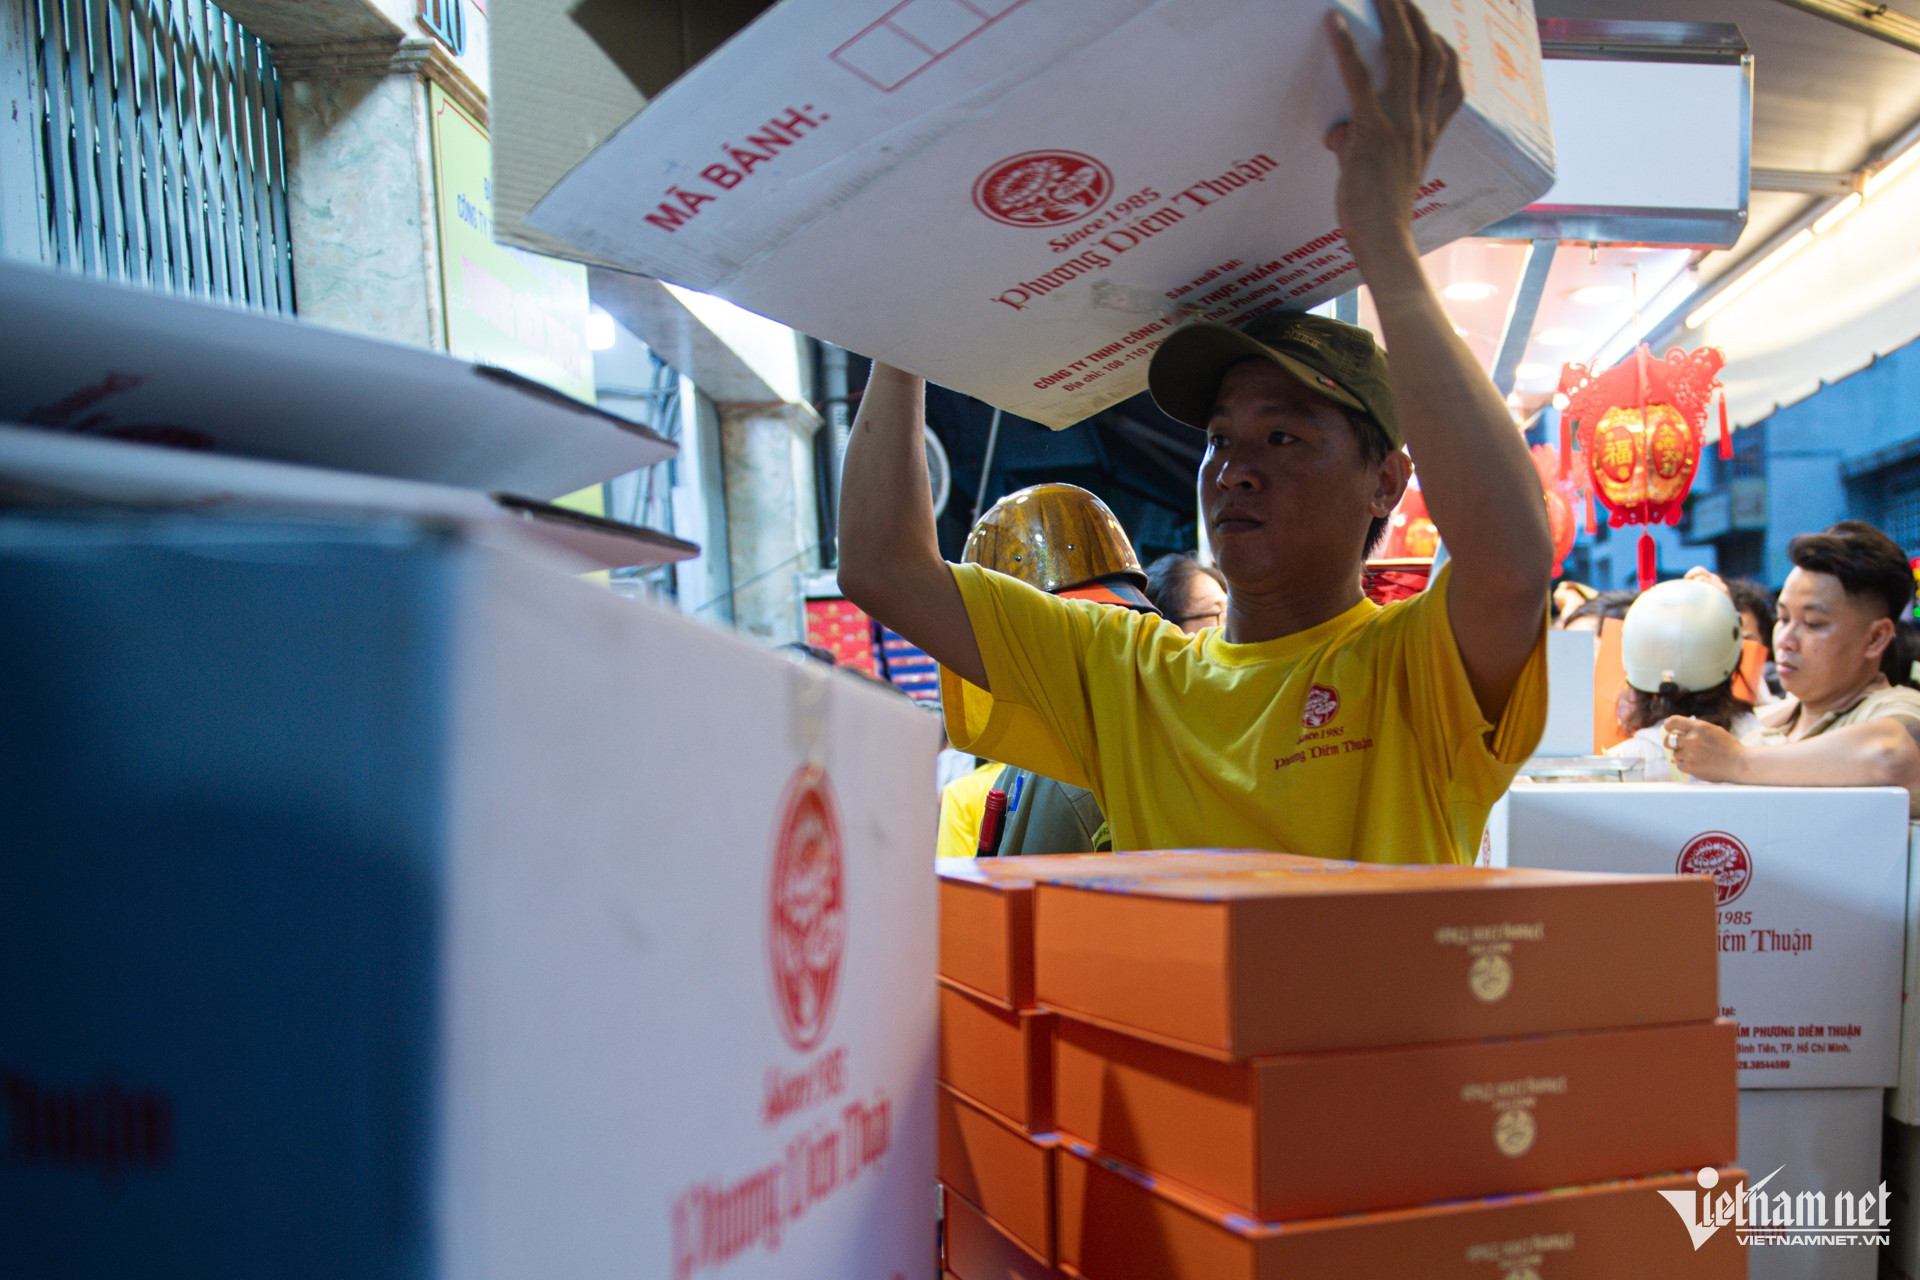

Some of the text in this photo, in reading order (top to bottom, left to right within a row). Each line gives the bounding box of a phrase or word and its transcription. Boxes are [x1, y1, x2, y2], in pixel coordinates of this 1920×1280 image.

[643, 104, 831, 233] MÃ BÁNH:
[1170, 153, 1280, 213] Thuận
[1048, 187, 1161, 253] Since 1985
[1033, 321, 1164, 390] CÔNG TY TNHH CÔNG
[1602, 438, 1634, 467] 福
[1717, 928, 1812, 956] iêm Thuận
